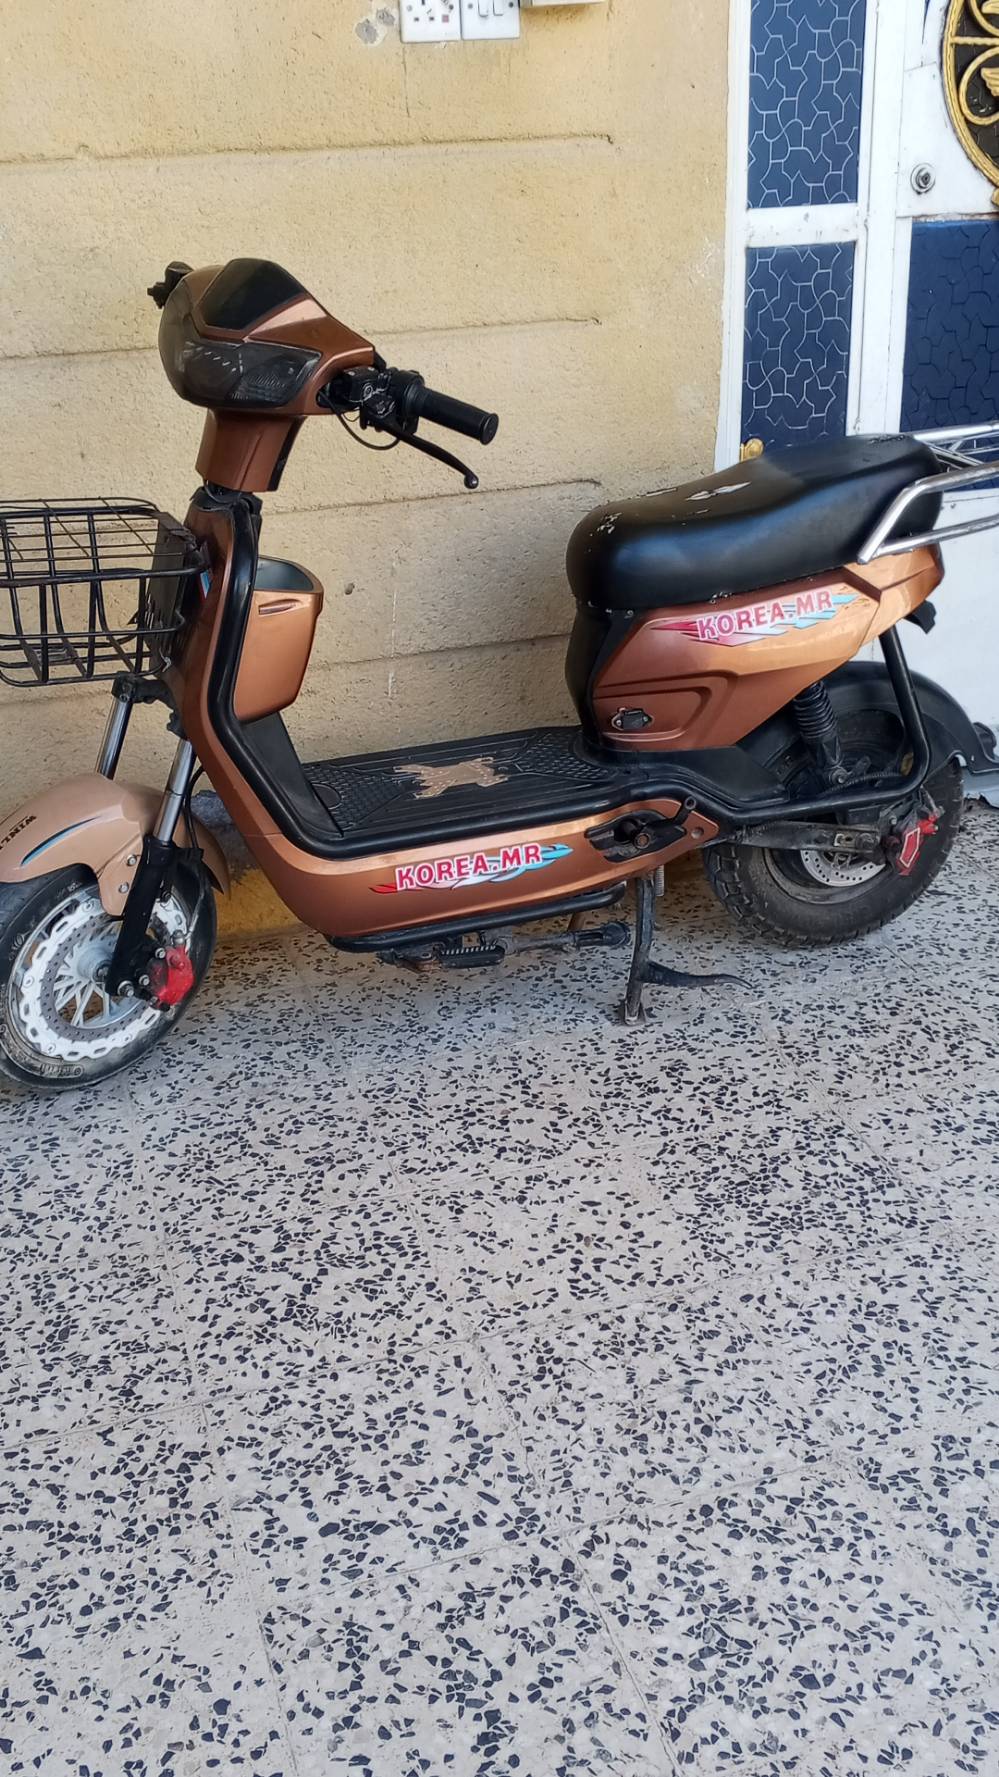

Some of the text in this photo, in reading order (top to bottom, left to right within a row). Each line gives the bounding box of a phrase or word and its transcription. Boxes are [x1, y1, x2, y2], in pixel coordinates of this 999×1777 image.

[697, 588, 833, 640] KOREA.MR
[0, 815, 37, 850] WINL
[395, 843, 541, 890] KOREA.MR
